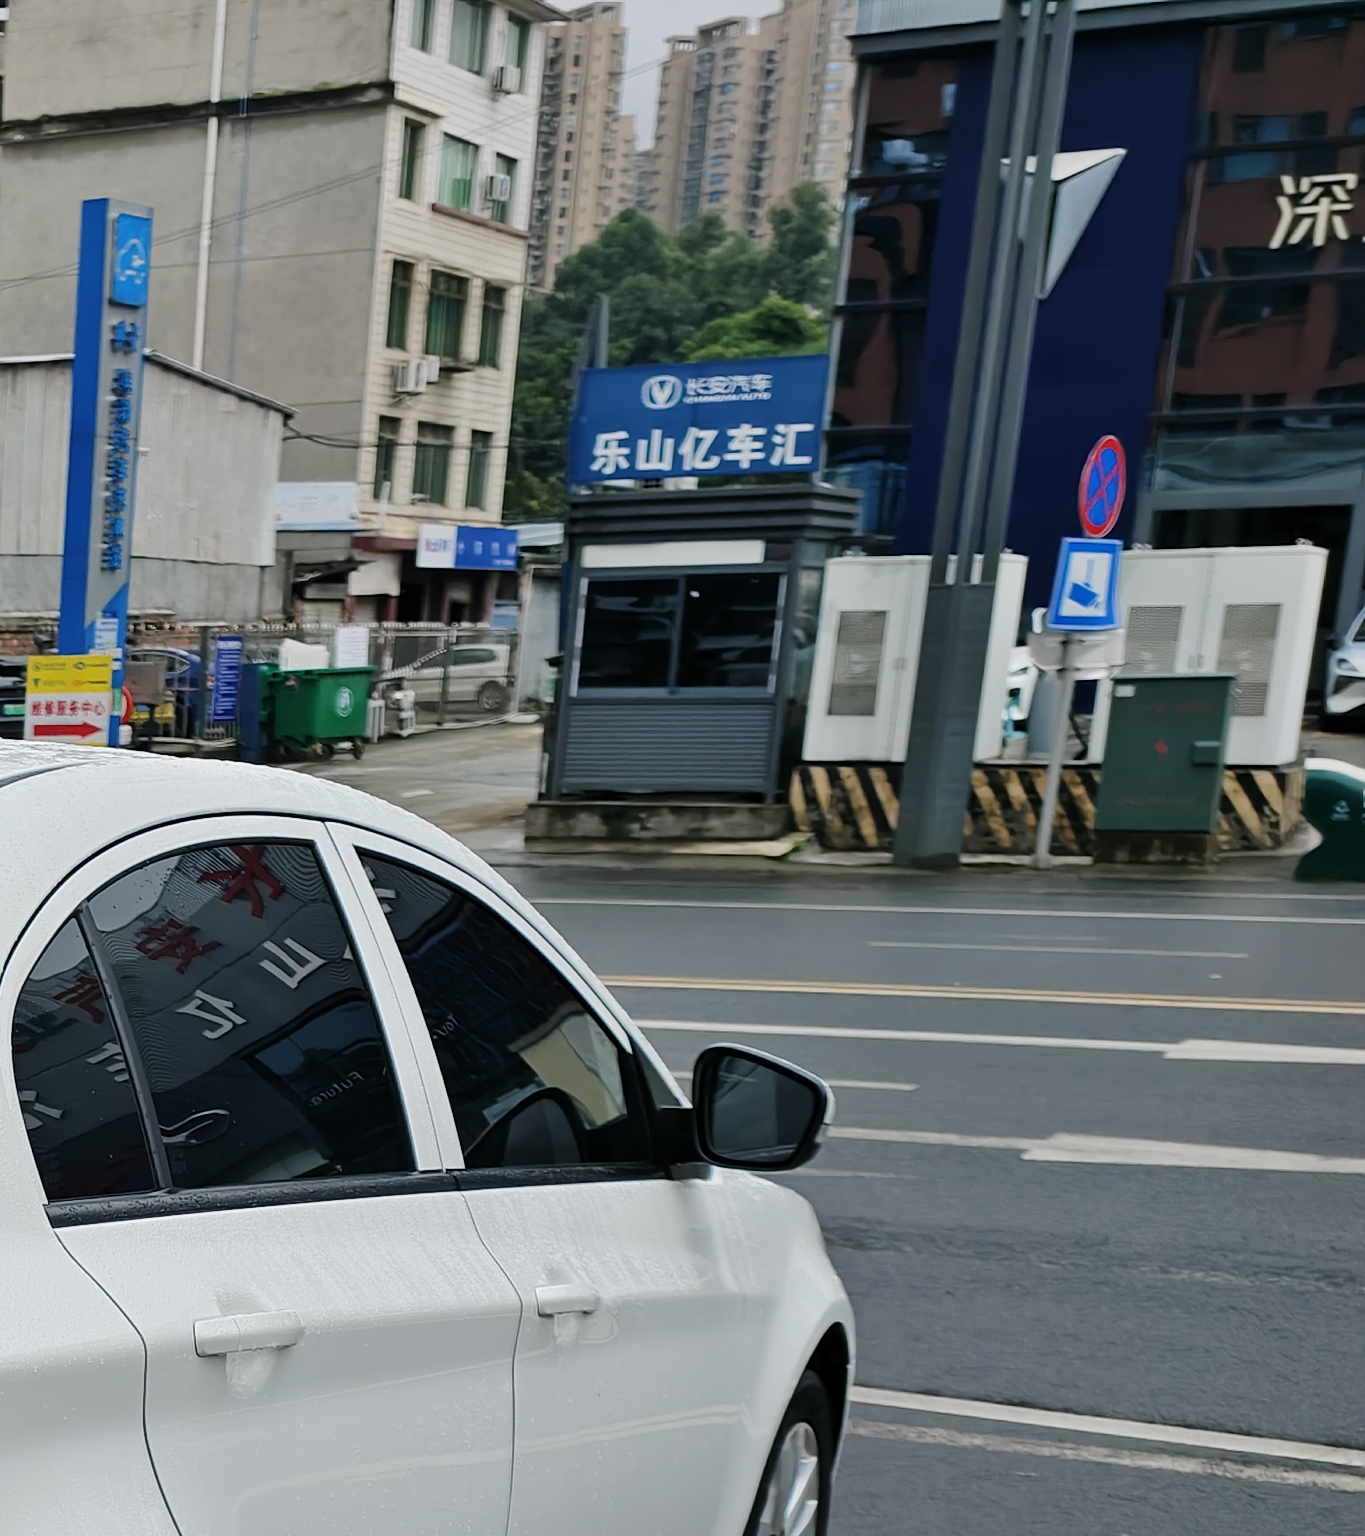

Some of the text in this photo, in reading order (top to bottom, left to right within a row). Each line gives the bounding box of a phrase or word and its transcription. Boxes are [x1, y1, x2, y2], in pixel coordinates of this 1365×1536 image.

[685, 374, 773, 395] 长安汽车
[590, 423, 815, 475] 乐山亿车汇
